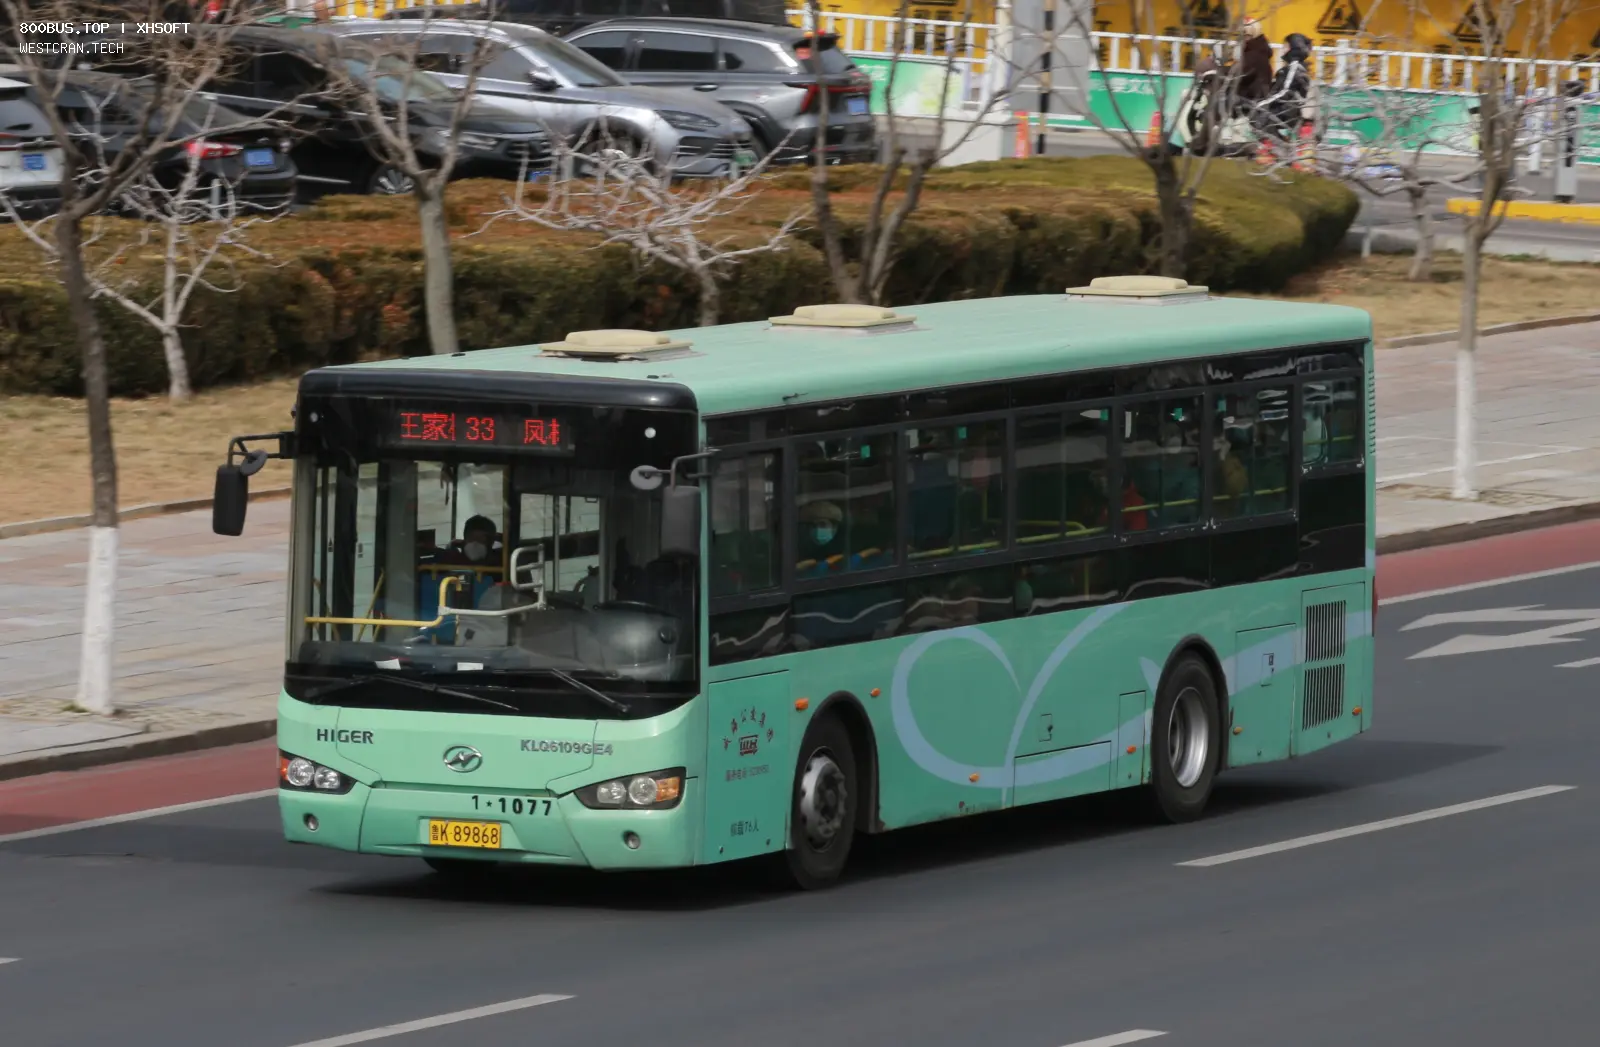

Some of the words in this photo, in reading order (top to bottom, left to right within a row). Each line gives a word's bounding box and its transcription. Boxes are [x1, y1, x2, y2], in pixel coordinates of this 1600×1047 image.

[465, 416, 495, 441] 33
[316, 727, 374, 745] HIGER
[520, 738, 614, 757] KLQ6109GE4
